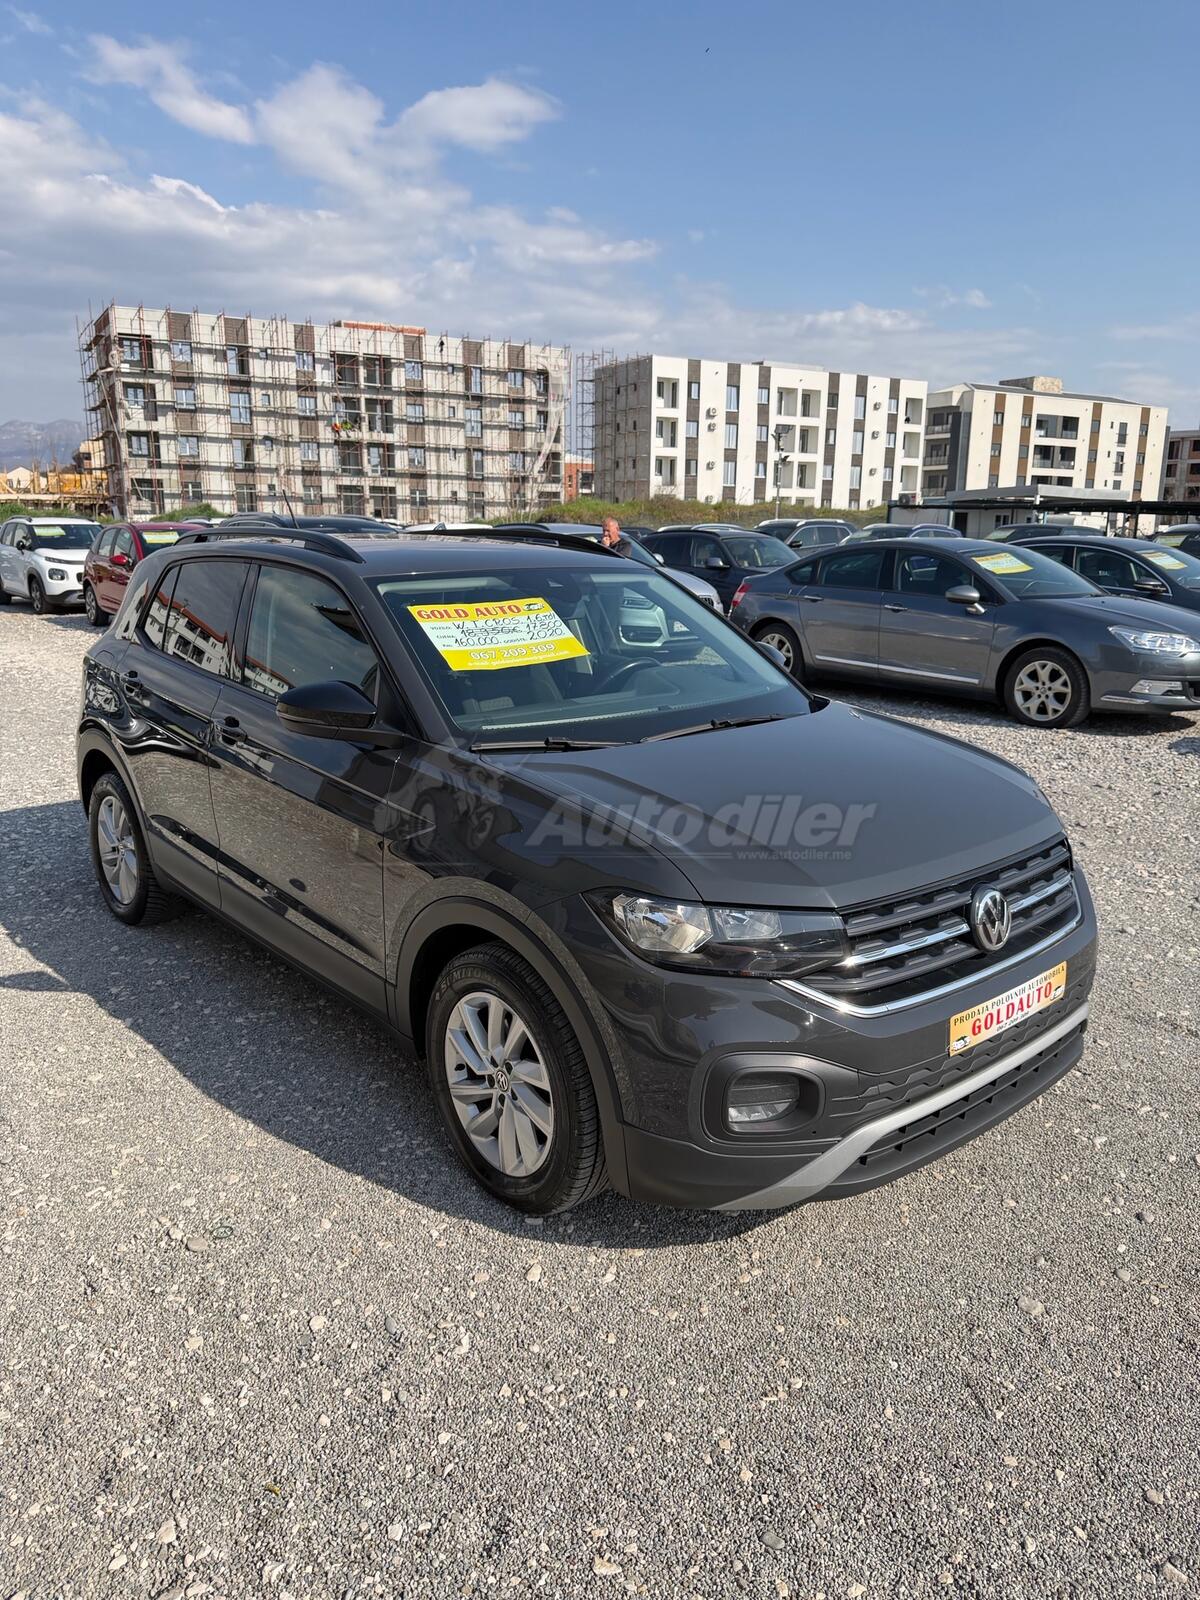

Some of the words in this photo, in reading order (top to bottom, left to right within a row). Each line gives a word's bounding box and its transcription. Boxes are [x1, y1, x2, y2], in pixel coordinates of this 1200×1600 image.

[416, 607, 469, 619] GOLD
[475, 604, 521, 617] AUTO
[470, 650, 496, 660] 067
[501, 647, 527, 658] 209
[530, 643, 555, 654] 309
[953, 1005, 989, 1026] PRODAJA
[991, 987, 1026, 1012] POLOVNIH
[1028, 965, 1065, 990] AUTOMOBILA
[971, 981, 1052, 1036] GOLDAUTO
